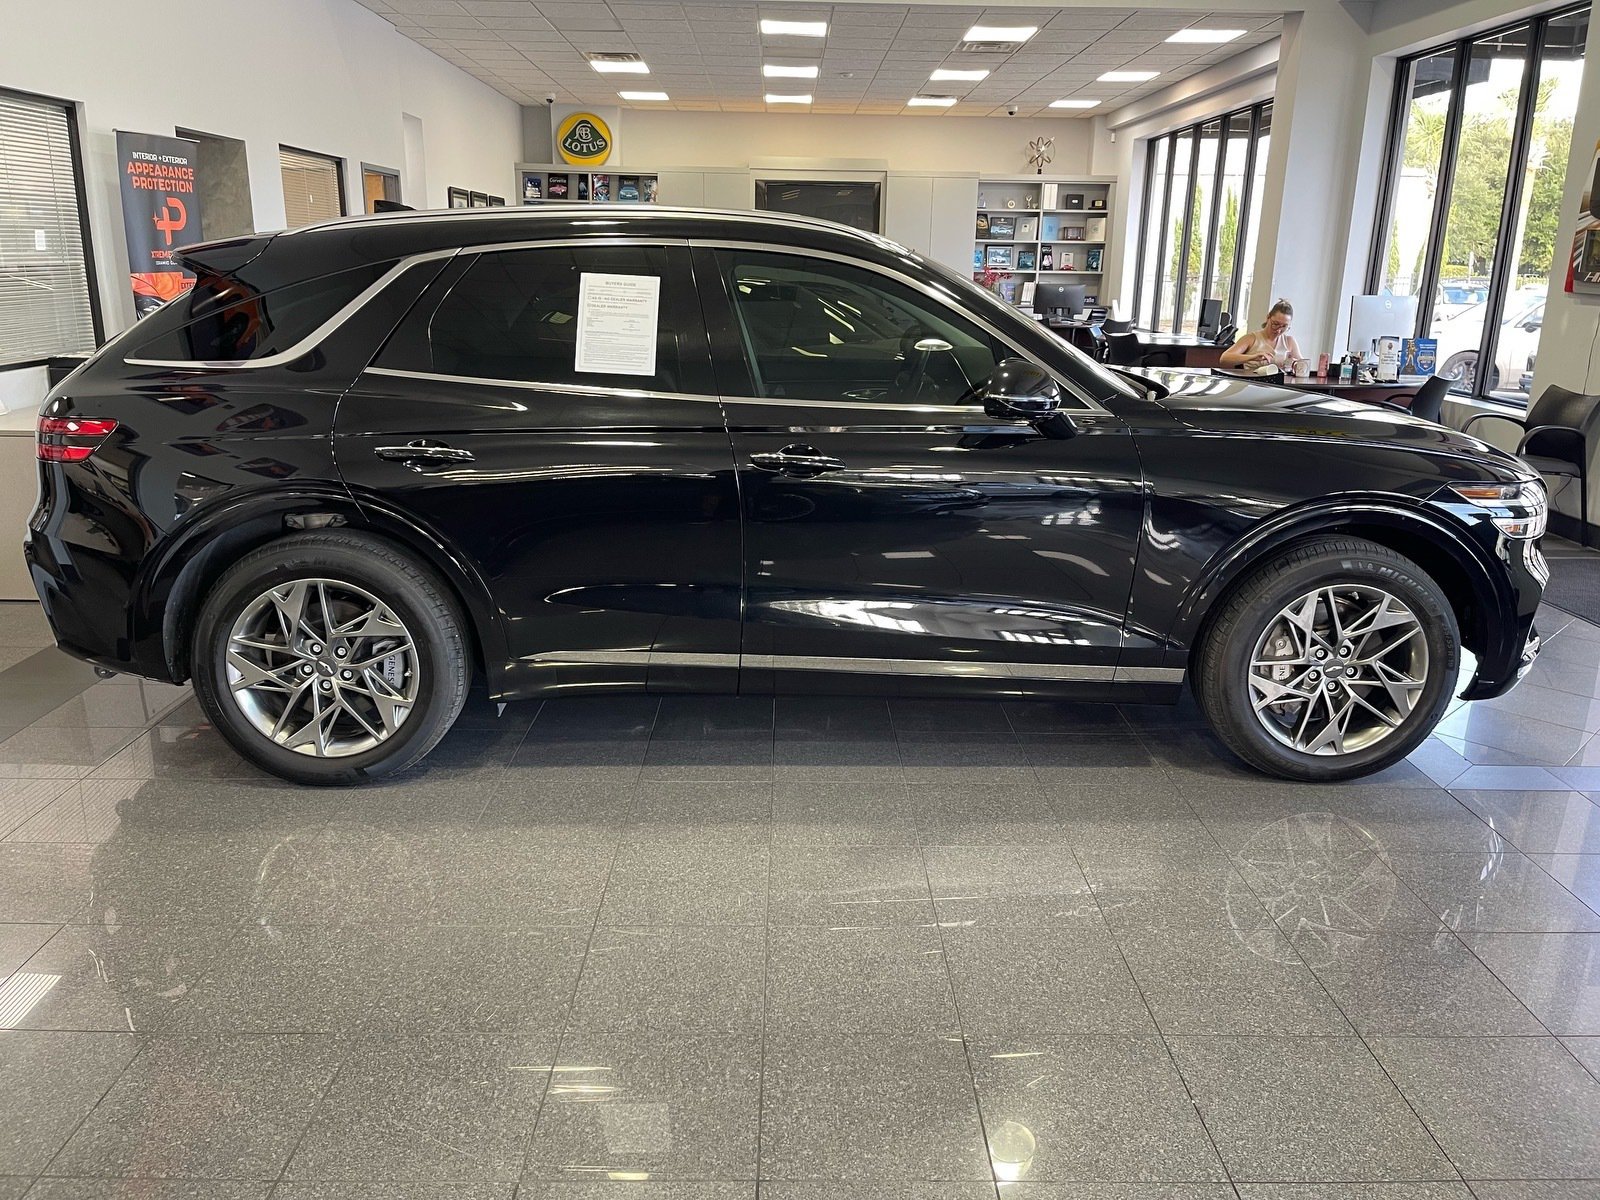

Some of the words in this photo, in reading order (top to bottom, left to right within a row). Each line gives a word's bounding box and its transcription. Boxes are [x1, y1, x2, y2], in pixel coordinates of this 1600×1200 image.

[564, 138, 606, 153] LOTUS
[131, 151, 158, 162] INTERIOR
[162, 155, 188, 165] EXTERIOR
[127, 161, 194, 180] APPEARANCE
[132, 176, 193, 193] PROTECTION
[387, 655, 396, 685] GENES
